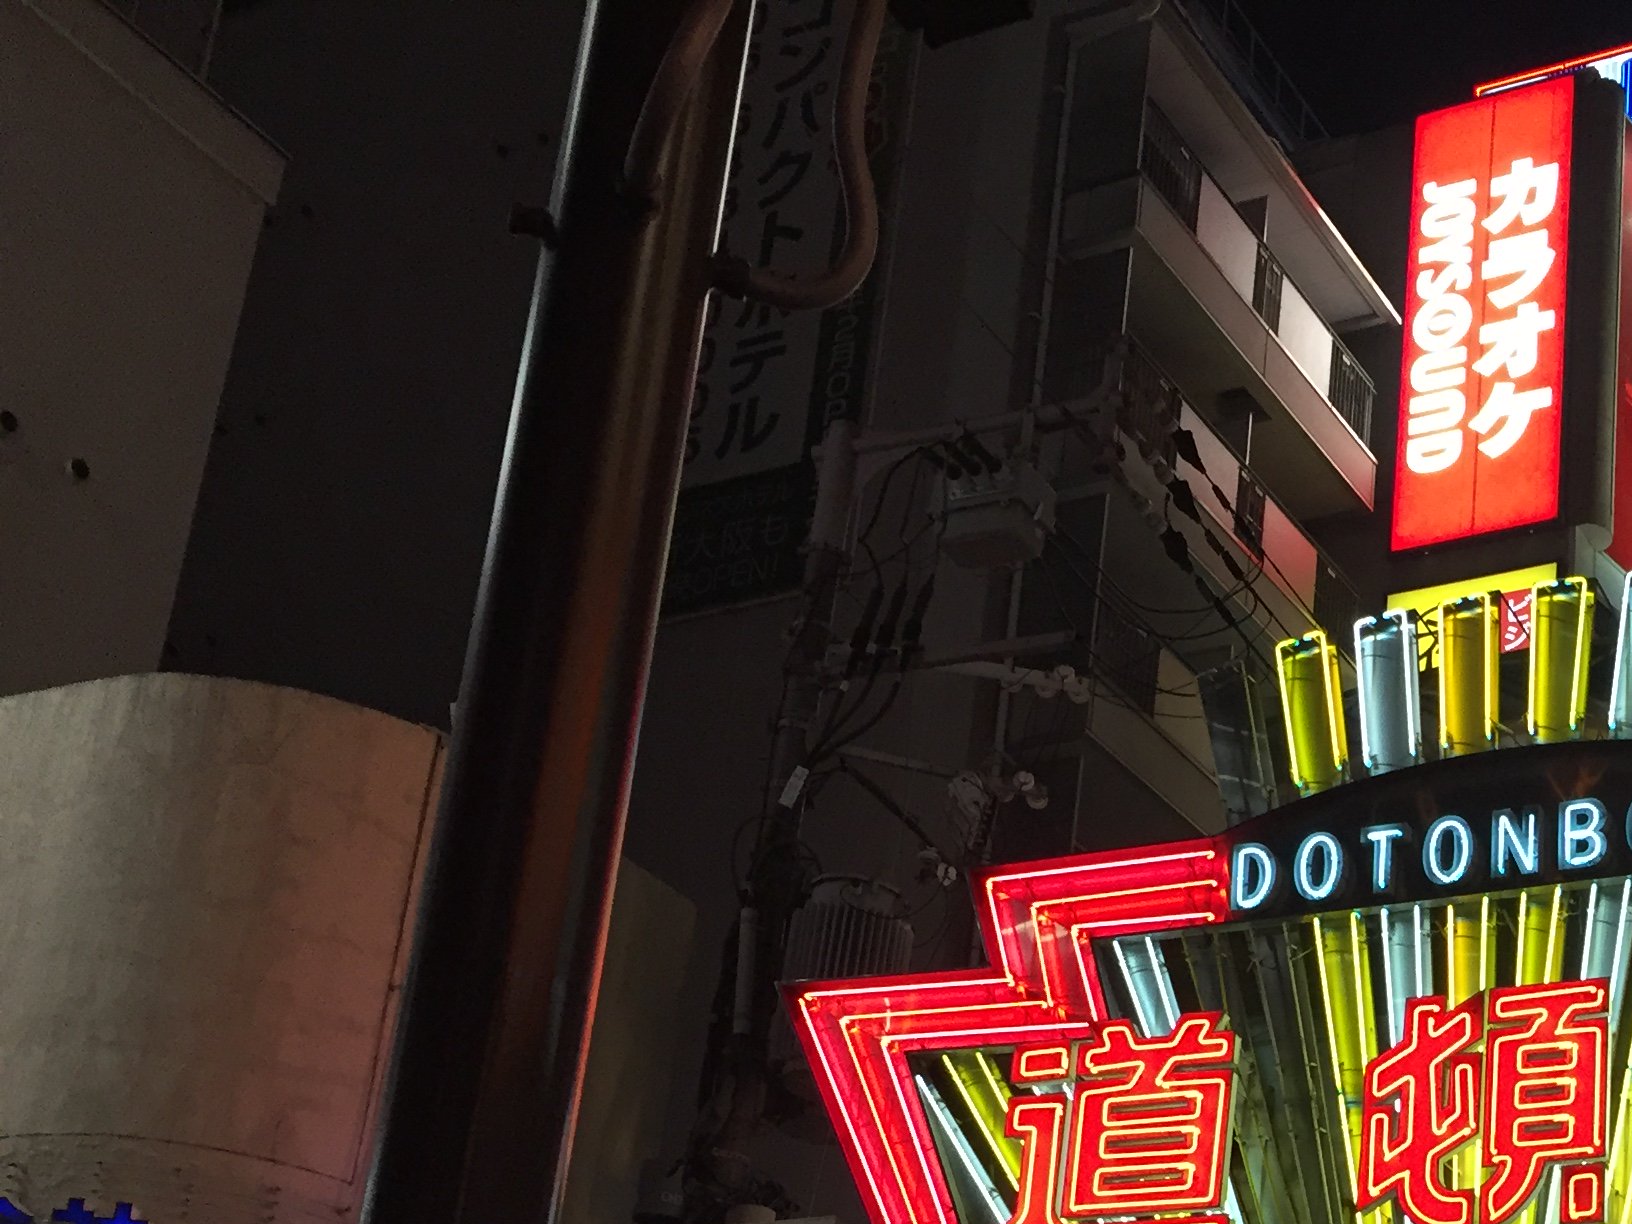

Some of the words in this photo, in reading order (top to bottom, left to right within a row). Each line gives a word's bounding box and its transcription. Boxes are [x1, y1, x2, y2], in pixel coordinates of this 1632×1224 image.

[1406, 180, 1477, 475] JOYSOUND
[1470, 157, 1559, 459] カラオケ
